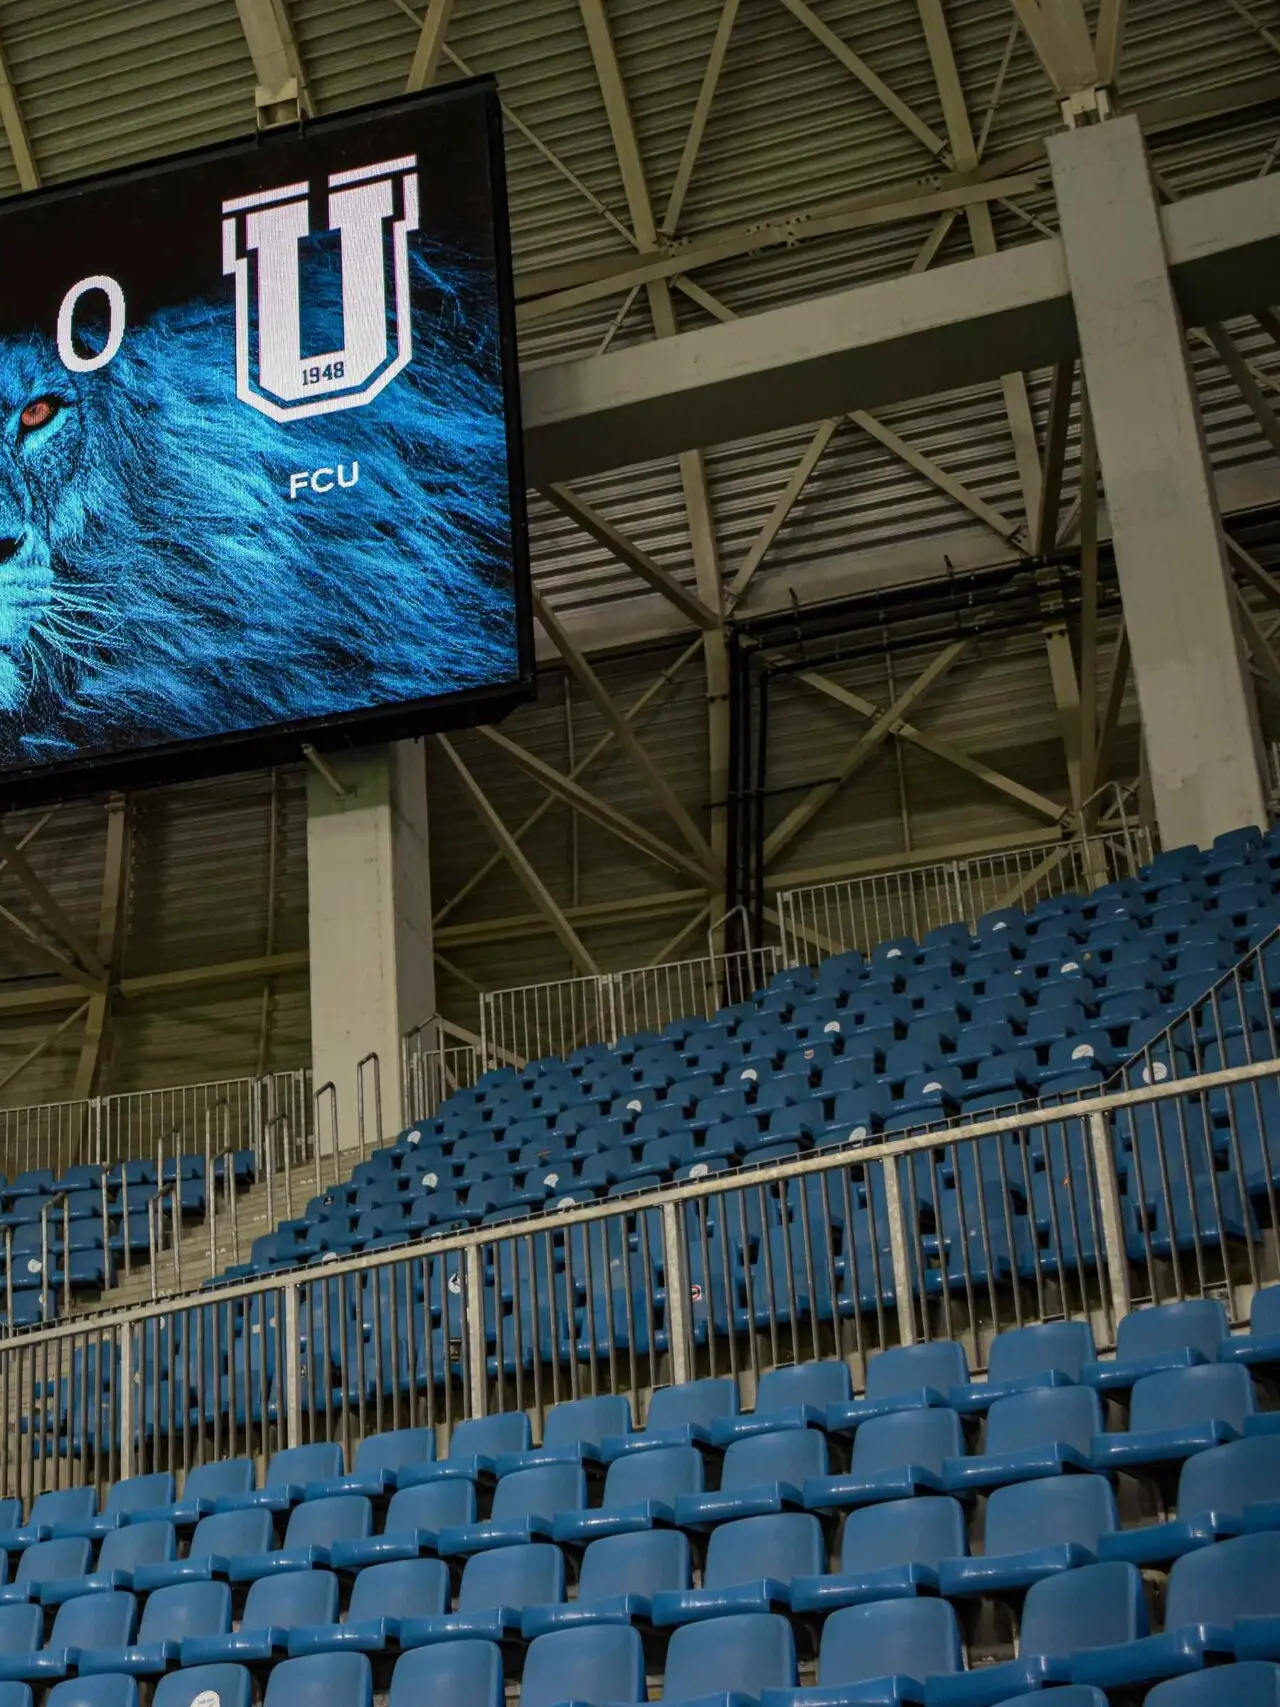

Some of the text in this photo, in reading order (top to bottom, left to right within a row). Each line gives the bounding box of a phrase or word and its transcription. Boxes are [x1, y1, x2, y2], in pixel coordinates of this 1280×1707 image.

[56, 274, 126, 373] 0
[301, 361, 345, 386] 1948
[289, 461, 360, 499] FCU
